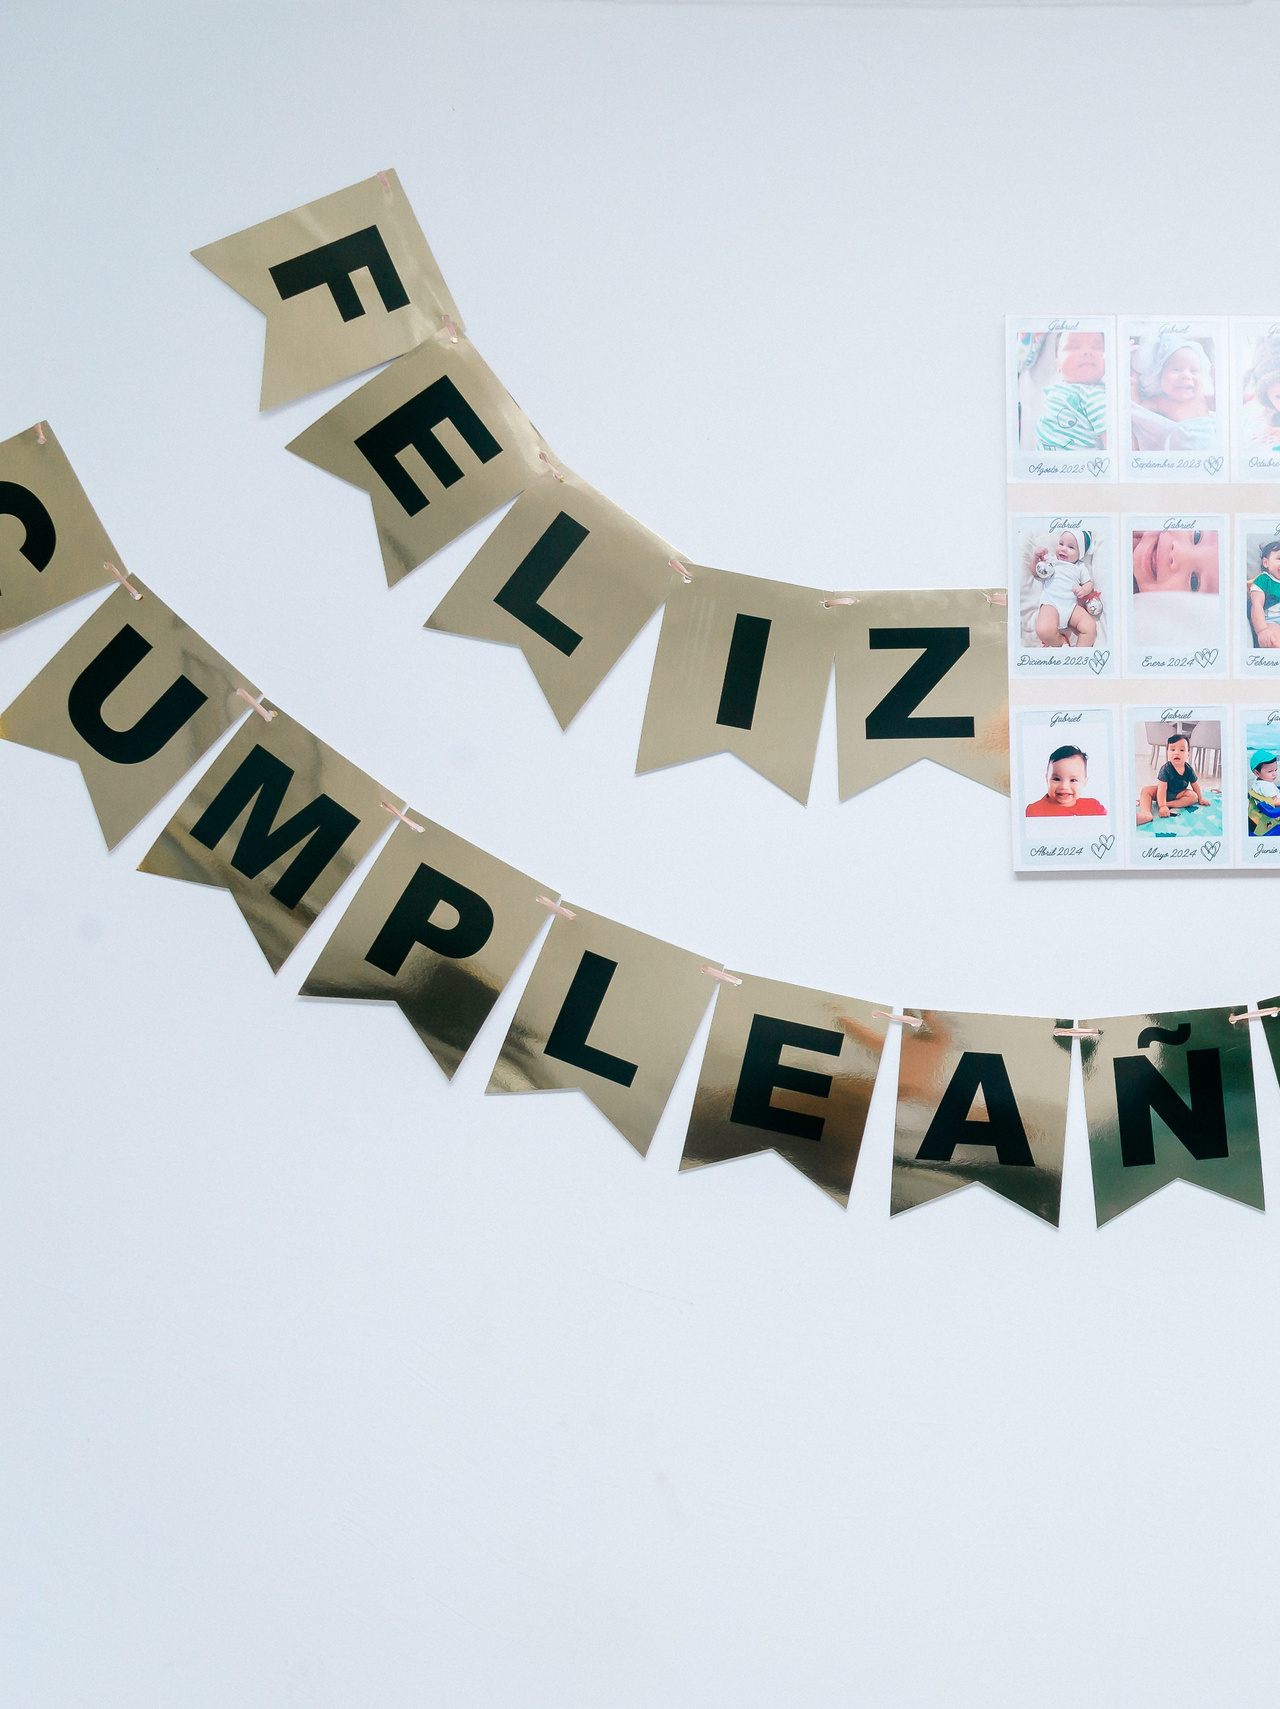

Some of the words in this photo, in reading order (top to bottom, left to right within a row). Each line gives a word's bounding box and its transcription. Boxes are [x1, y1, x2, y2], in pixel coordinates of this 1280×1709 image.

[1048, 320, 1079, 333] Gabriel
[1158, 323, 1190, 339] Gabriel
[1029, 462, 1059, 475] Agosto
[1060, 465, 1085, 474] 2023
[1131, 457, 1175, 470] Septiembre
[1176, 460, 1201, 468] 2023
[1248, 456, 1280, 468] Octubre
[268, 224, 975, 740] FELIZ
[1049, 518, 1082, 533] Gabriel
[1163, 518, 1196, 532] Gabriel
[1017, 655, 1061, 666] Diciembre
[1063, 657, 1089, 665] 2023
[1142, 656, 1165, 667] Enero
[1167, 658, 1194, 667] 2024
[1246, 655, 1279, 667] Febrero
[1050, 712, 1082, 727] Gabriel
[1160, 708, 1193, 723] Gabriel
[1030, 846, 1056, 856] Abril
[1057, 847, 1083, 856] 2024
[1142, 848, 1169, 859] Mayo
[1170, 850, 1197, 858] 2024
[1254, 843, 1278, 858] Junio
